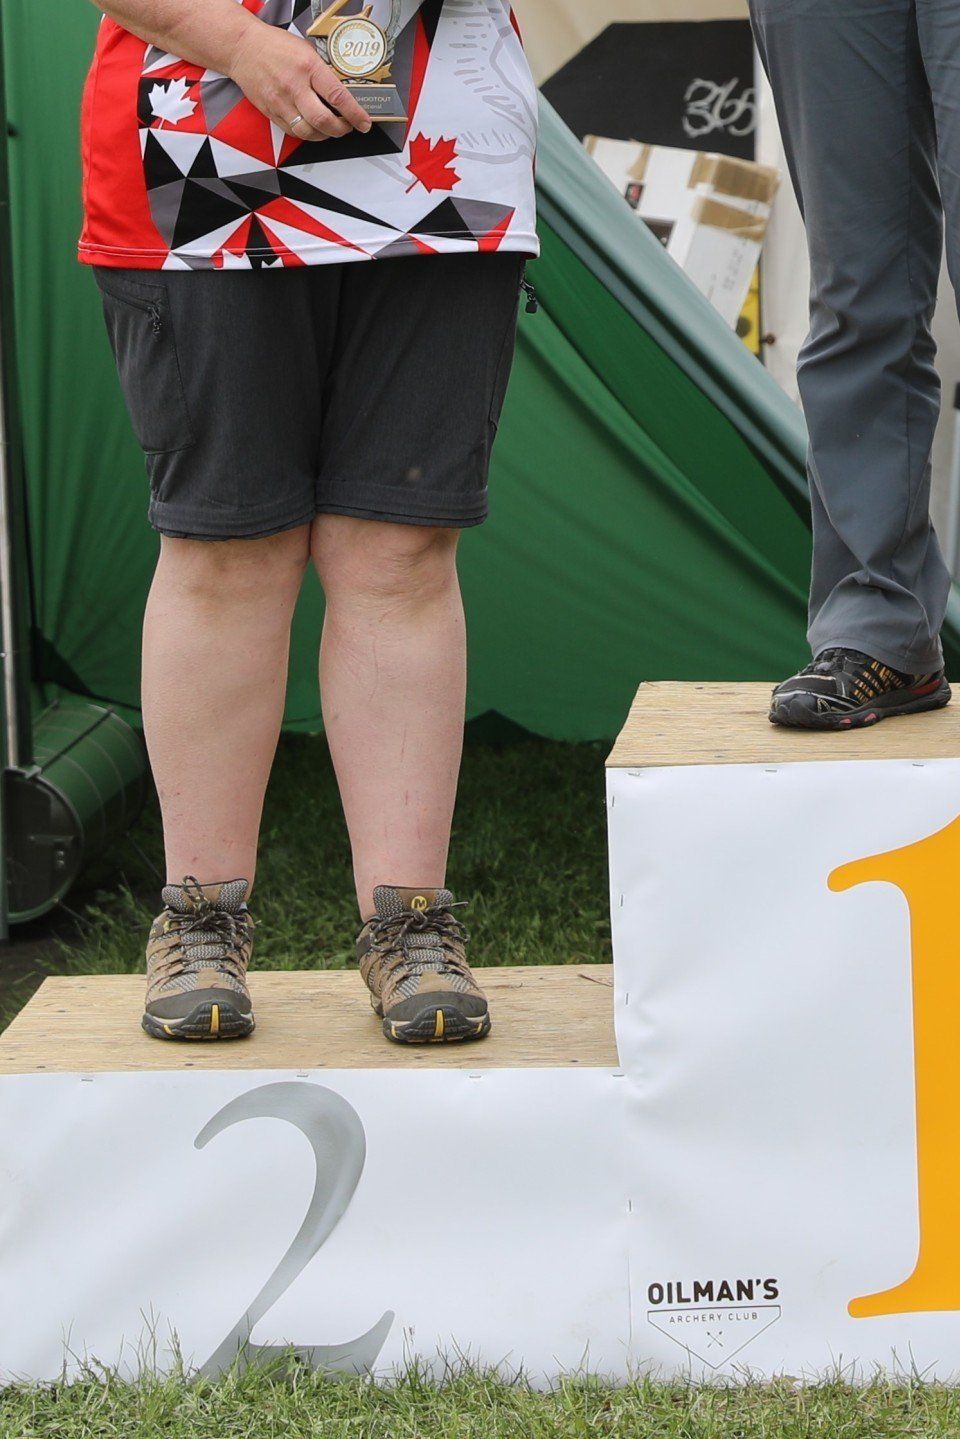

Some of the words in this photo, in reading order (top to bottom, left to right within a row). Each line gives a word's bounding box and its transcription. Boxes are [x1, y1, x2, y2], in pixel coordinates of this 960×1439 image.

[342, 40, 381, 58] 2019
[193, 1081, 395, 1380] 2
[648, 1278, 779, 1305] OILMAN'S
[669, 1313, 723, 1324] ARCHERY
[728, 1312, 759, 1321] CLUB
